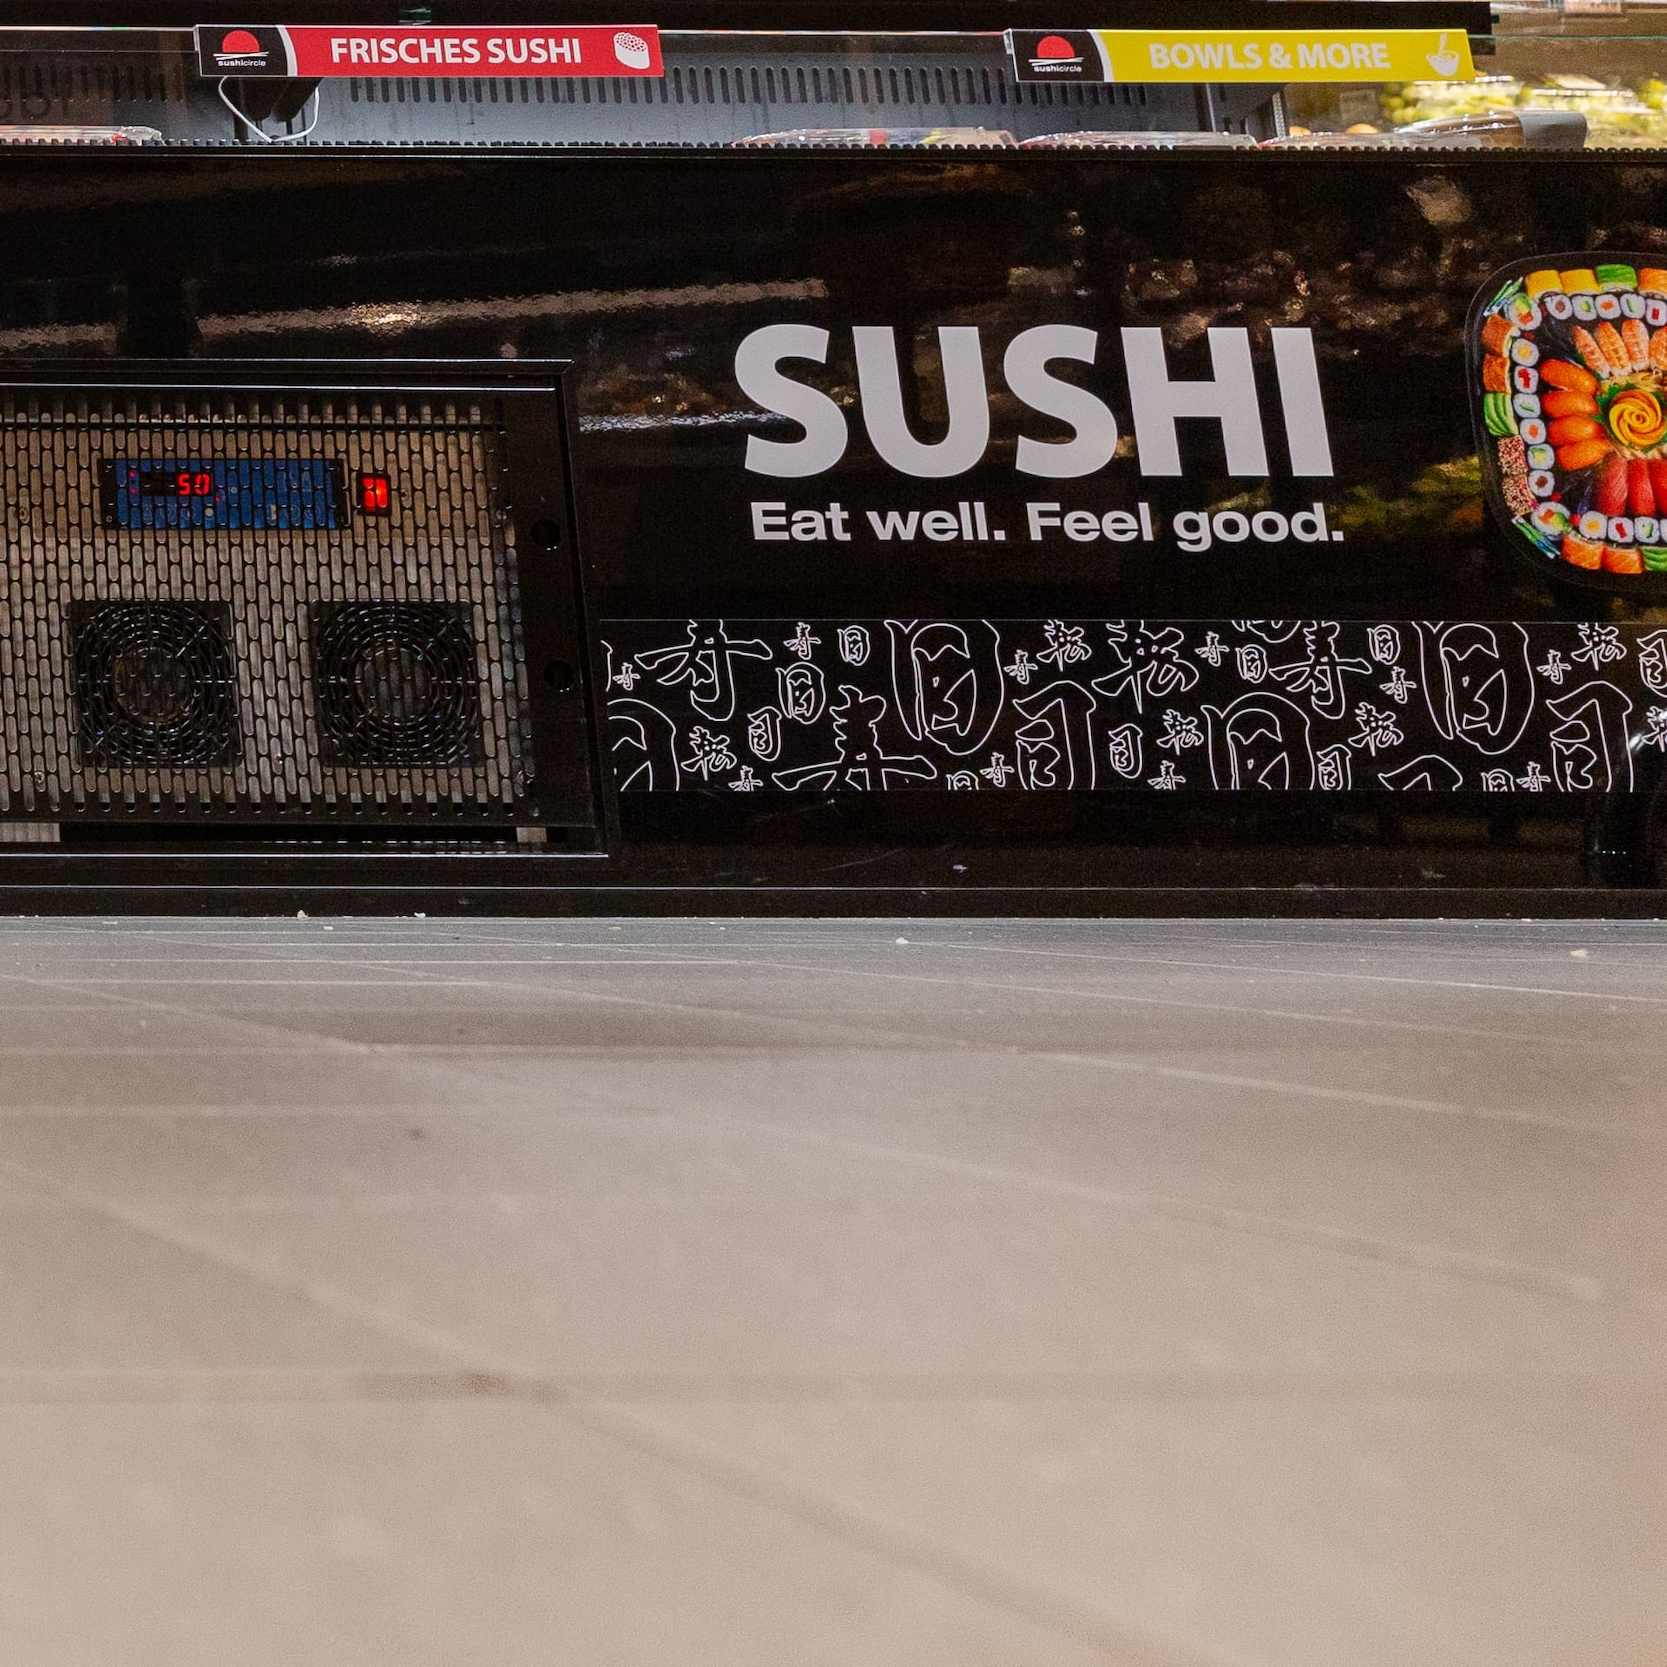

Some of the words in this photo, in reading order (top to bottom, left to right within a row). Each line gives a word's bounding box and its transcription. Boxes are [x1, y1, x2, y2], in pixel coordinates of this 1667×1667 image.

[330, 36, 479, 66] FRISCHES
[487, 36, 582, 66] SUSHI
[1149, 41, 1262, 71] BOWLS
[1268, 42, 1293, 70] &
[1297, 41, 1392, 70] MORE
[734, 323, 1335, 479] SUSHI
[750, 501, 852, 542] Eat
[866, 501, 1006, 542] well.
[1026, 502, 1154, 543] Feel
[1174, 502, 1345, 553] good.
